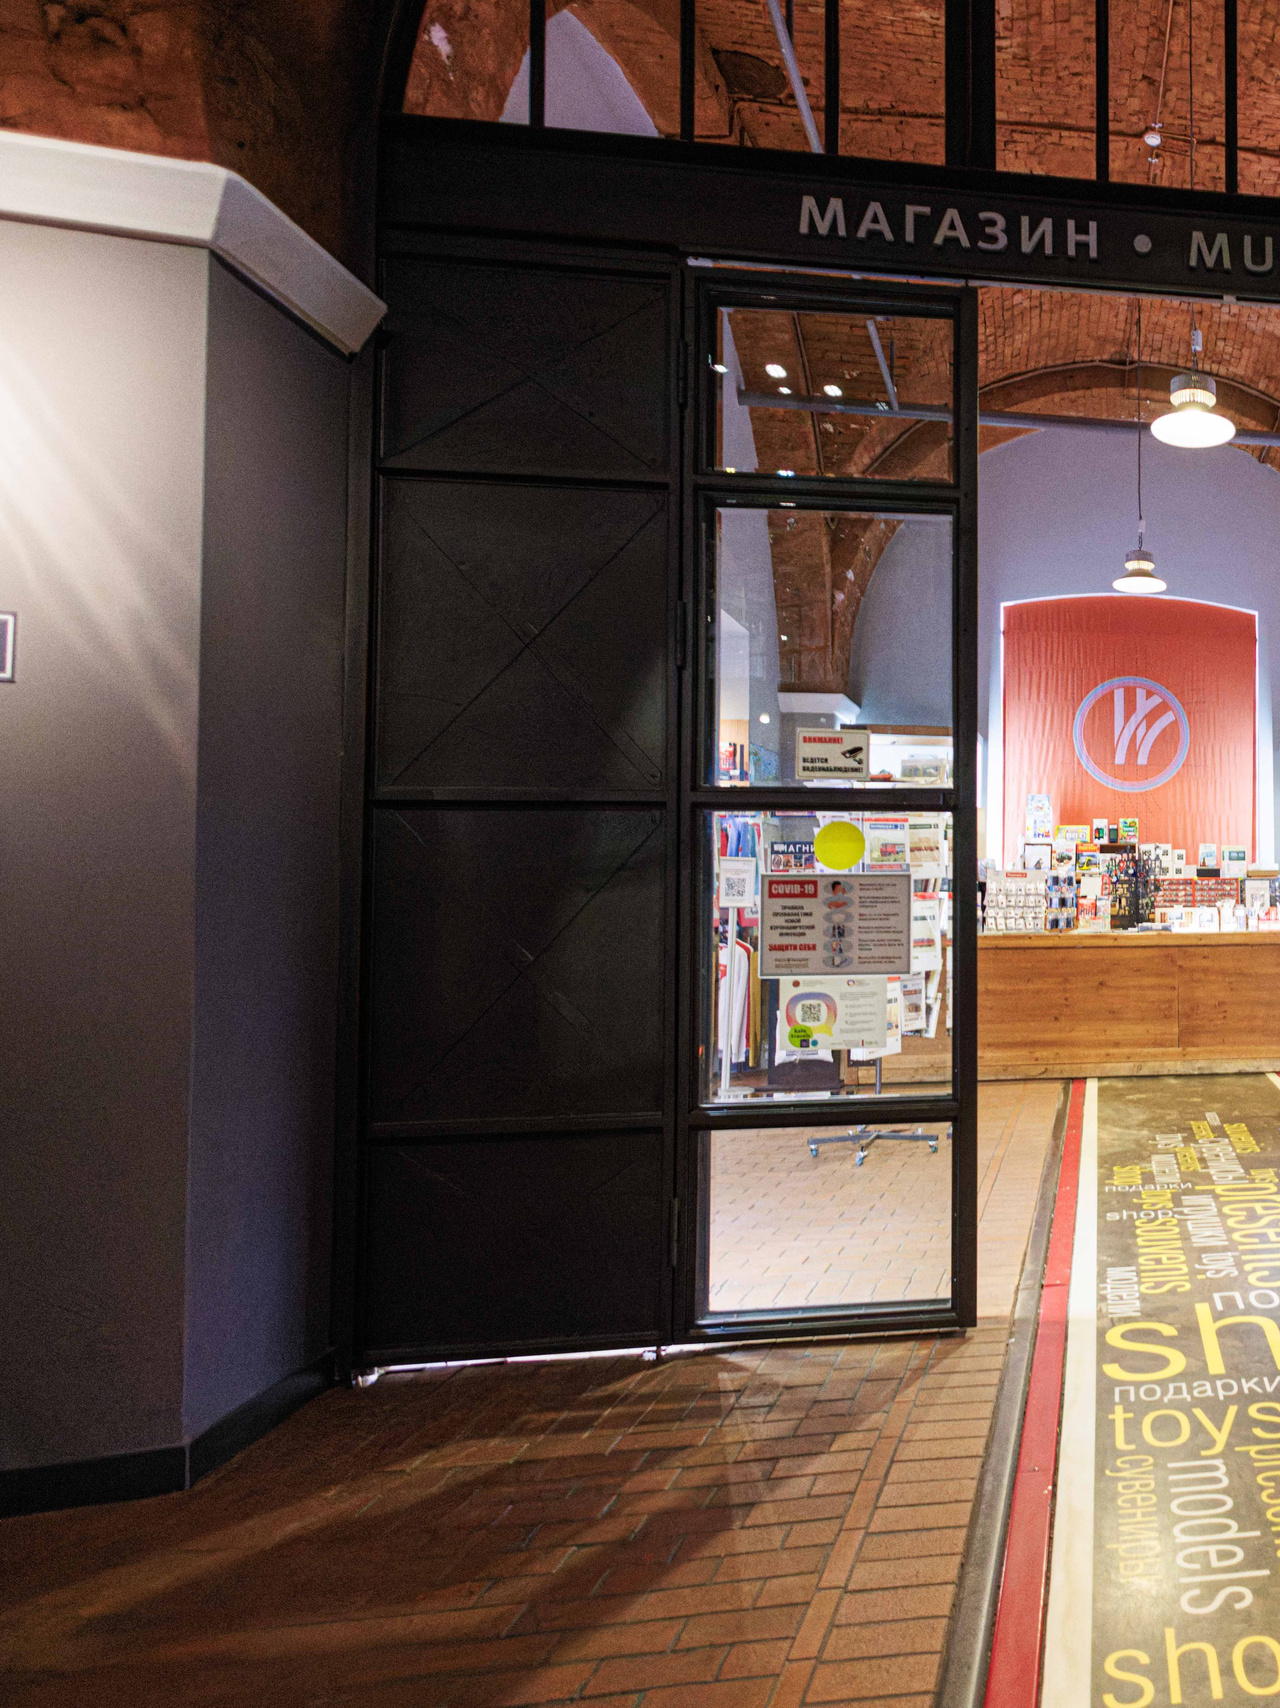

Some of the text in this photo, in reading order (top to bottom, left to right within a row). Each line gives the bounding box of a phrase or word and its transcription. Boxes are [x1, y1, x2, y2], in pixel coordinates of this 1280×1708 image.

[798, 193, 1098, 261] МАГАЗИН
[802, 735, 844, 745] ВНИМАНИЕ!
[771, 883, 815, 894] COVID-19
[768, 943, 817, 952] ЗАЩИТИ СЕБЯ
[1105, 1182, 1193, 1192] подарки
[1133, 1189, 1177, 1210] toys
[1106, 1209, 1173, 1222] shop
[1172, 1194, 1230, 1247] игрушки
[1195, 1252, 1240, 1279] toys
[1099, 1266, 1142, 1318] модели
[1167, 1458, 1271, 1615] models
